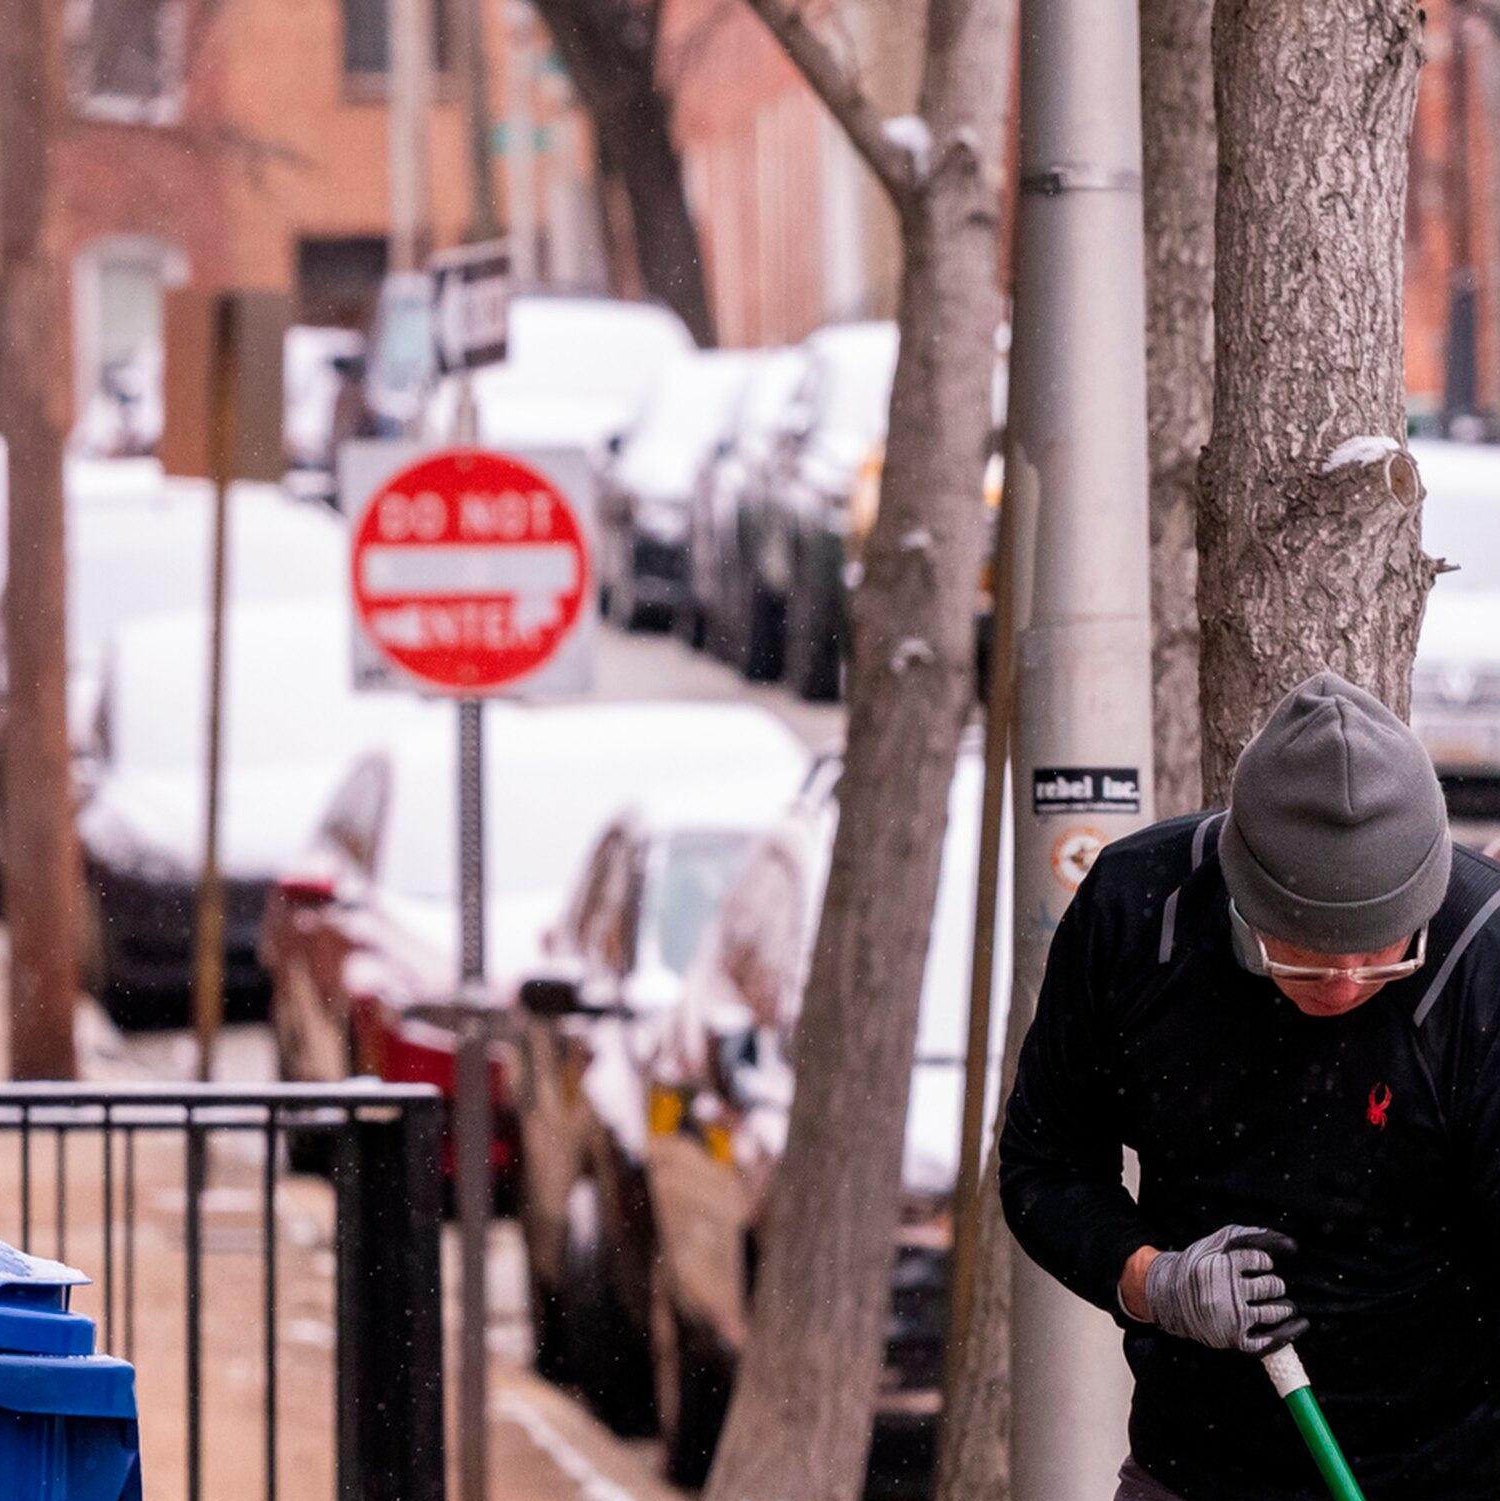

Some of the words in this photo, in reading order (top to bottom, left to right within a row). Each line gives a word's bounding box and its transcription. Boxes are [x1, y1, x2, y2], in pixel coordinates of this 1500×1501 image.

[378, 490, 447, 541] DO
[457, 490, 551, 540] NOT
[376, 603, 542, 650] NTE
[1036, 775, 1093, 799] rebel
